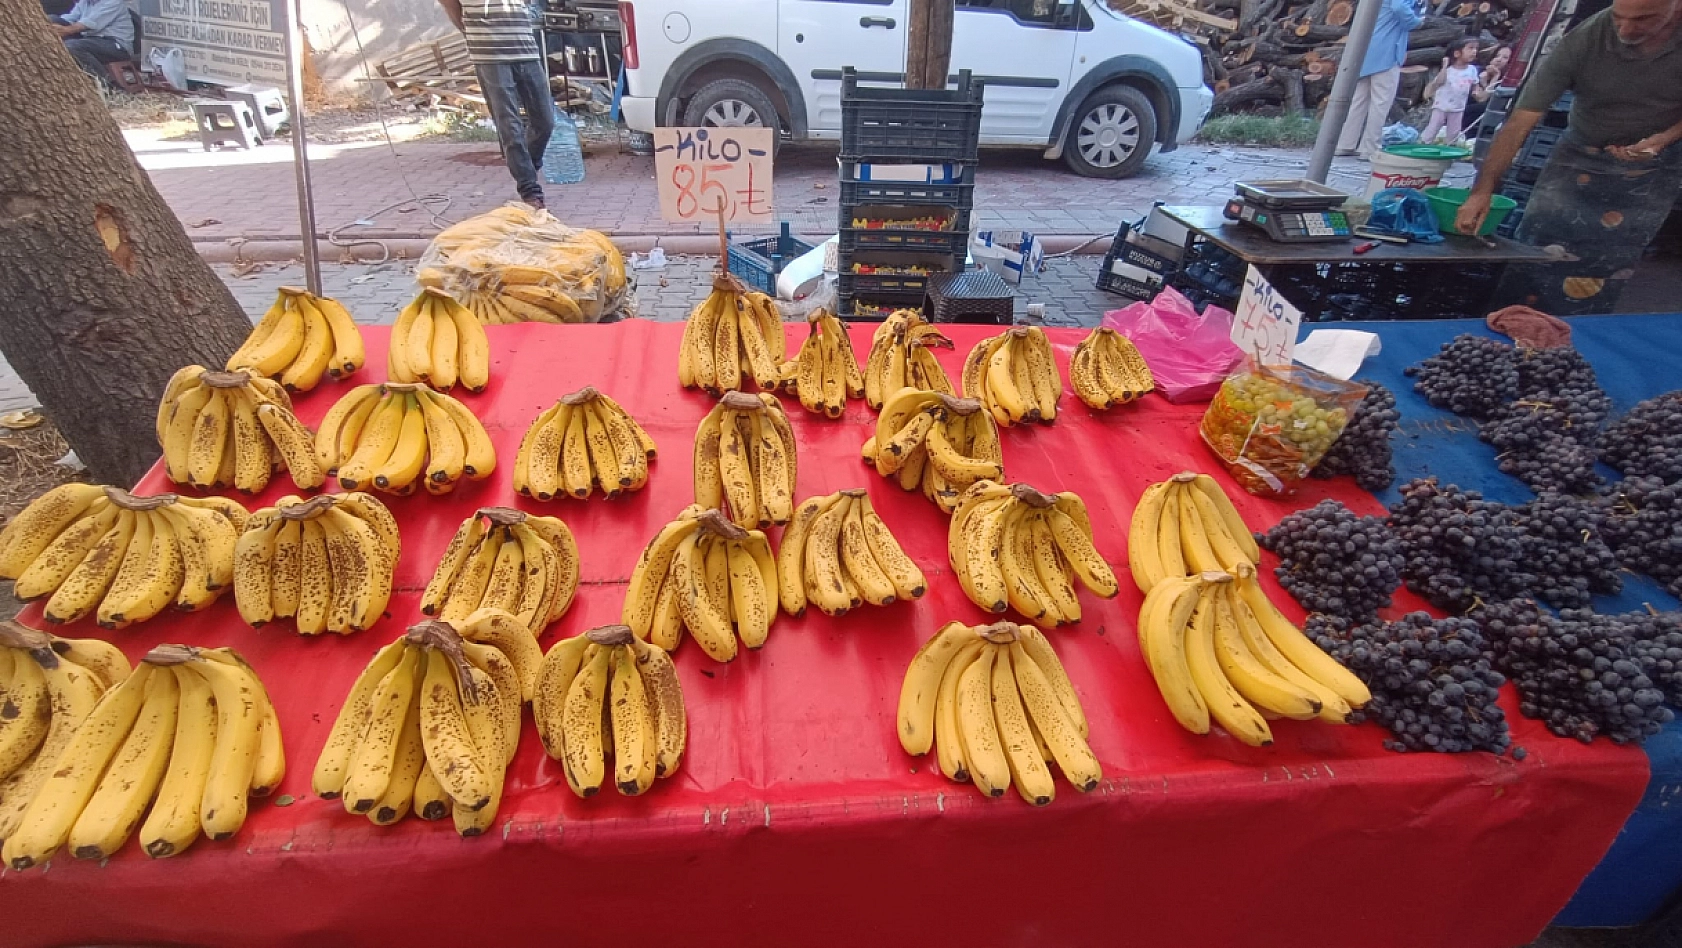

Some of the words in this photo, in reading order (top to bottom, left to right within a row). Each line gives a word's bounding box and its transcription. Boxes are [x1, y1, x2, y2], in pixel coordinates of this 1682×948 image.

[192, 0, 248, 23] ROJELERİNİZ
[191, 25, 226, 44] ALMDAN
[227, 31, 252, 49] KARAR
[253, 33, 285, 53] VERMEY
